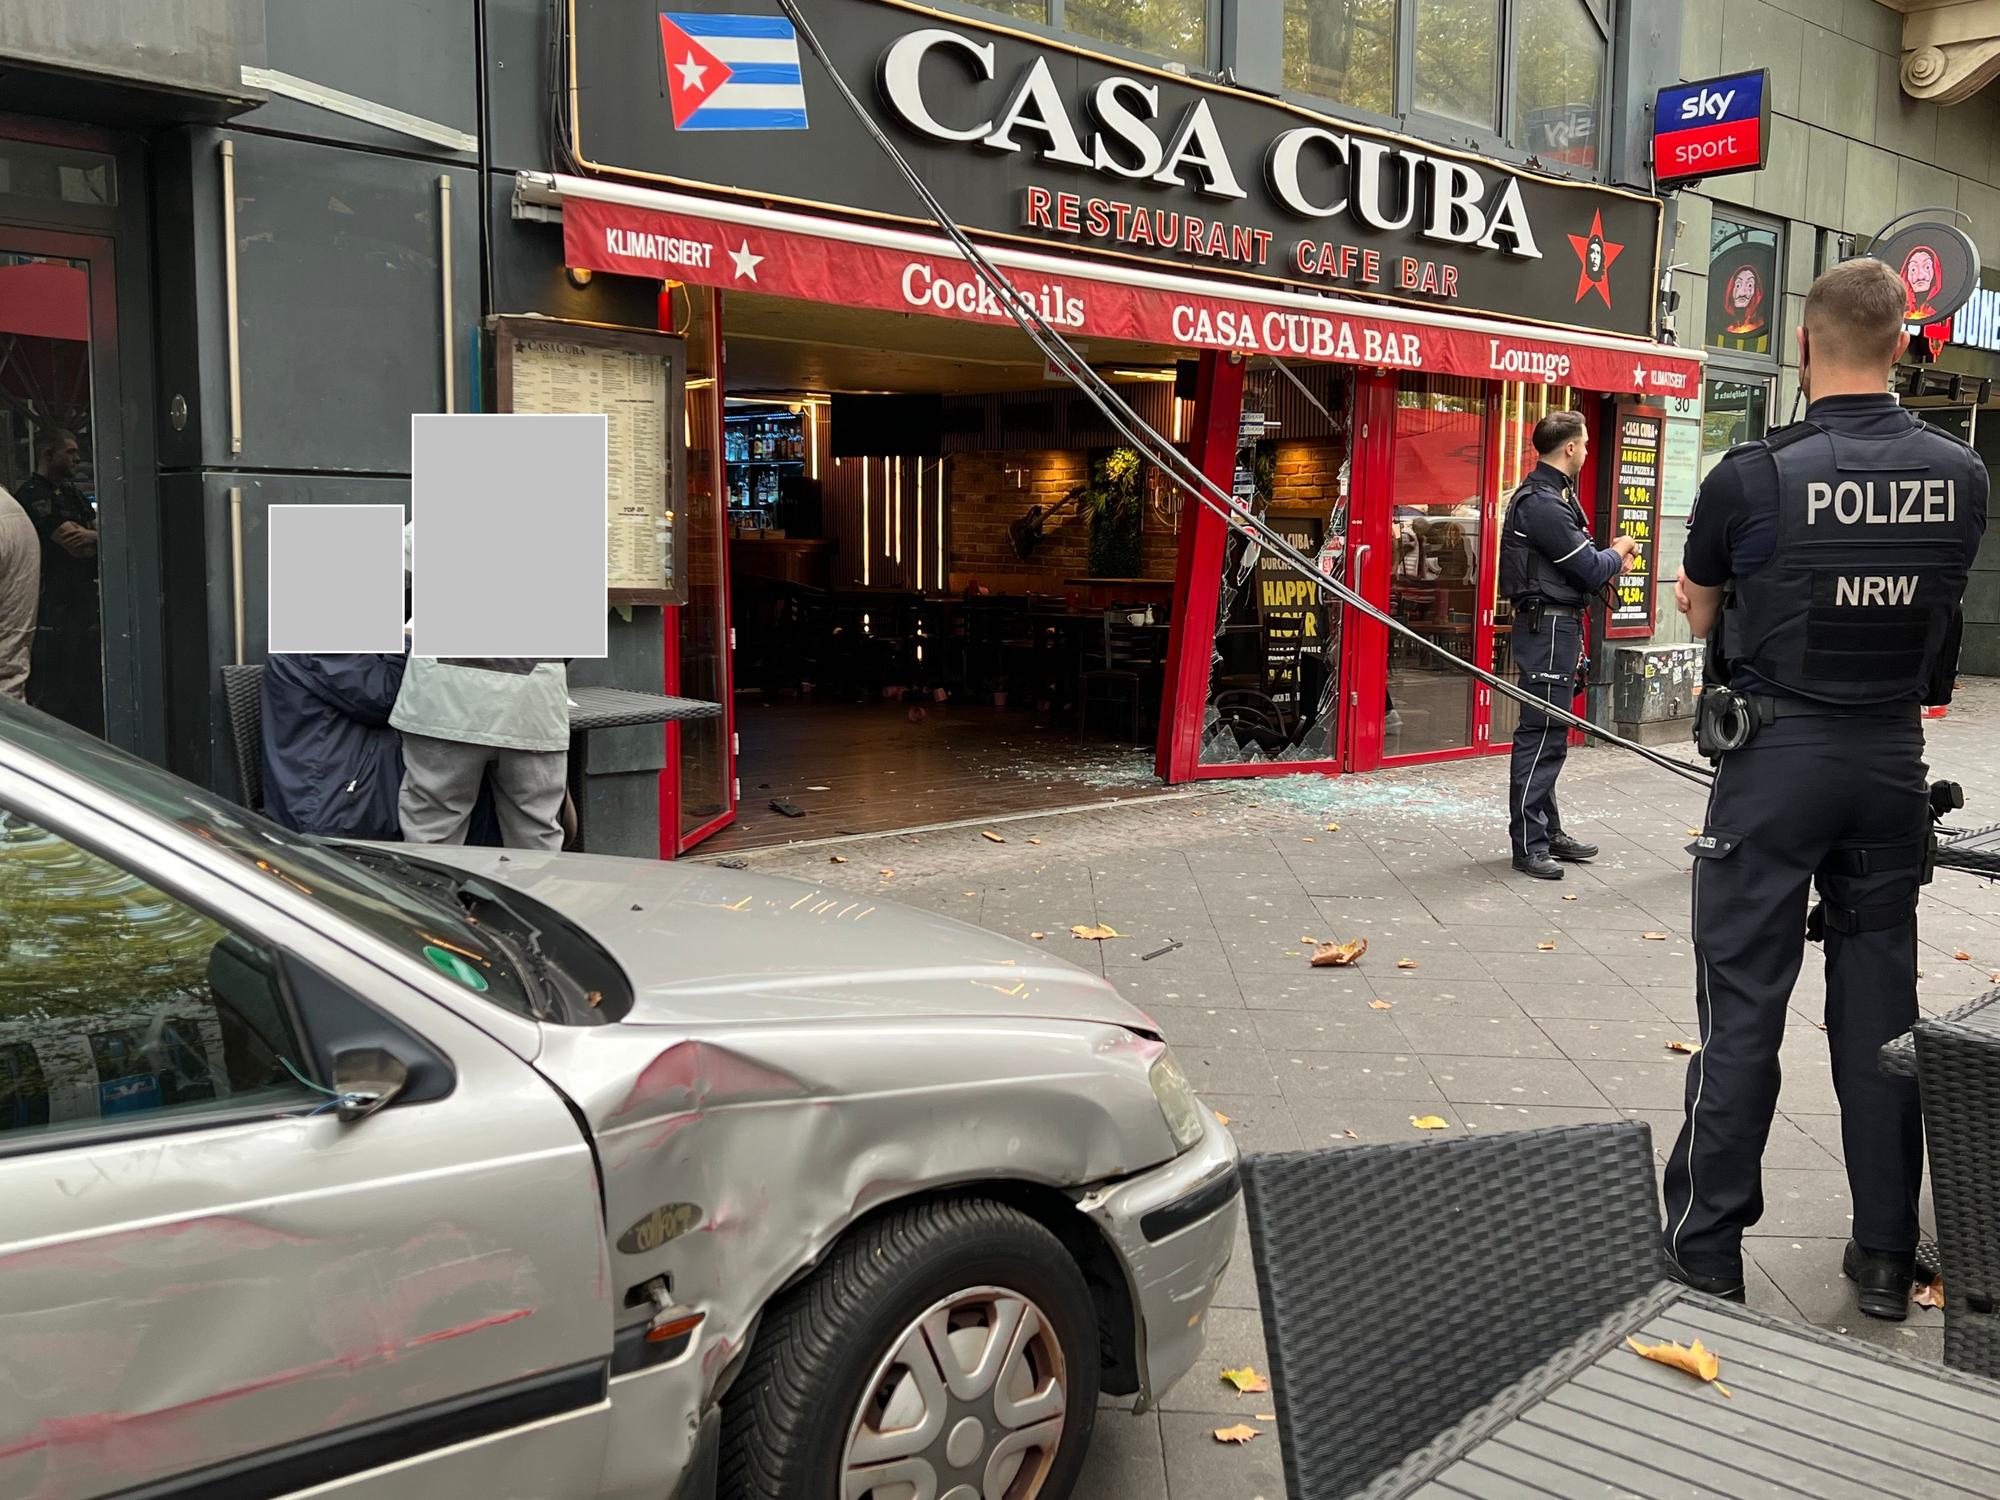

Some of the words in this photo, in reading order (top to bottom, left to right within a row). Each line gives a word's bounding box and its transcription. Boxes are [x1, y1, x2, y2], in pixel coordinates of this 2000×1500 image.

[1681, 88, 1736, 120] sky
[879, 28, 1248, 199] CASA
[1267, 126, 1543, 260] CUBA
[1675, 135, 1738, 165] sport
[605, 227, 714, 269] KLIMATISIERT
[1026, 185, 1273, 266] RESTAURANT
[1296, 239, 1380, 284] CAFE
[1401, 256, 1459, 298] BAR
[901, 262, 1085, 328] Cocktails
[1172, 304, 1259, 349] CASA
[1262, 311, 1360, 360] CUBA
[1363, 328, 1423, 368] BAR
[1489, 339, 1571, 384] Lounge
[1674, 396, 1690, 413] 30
[1625, 421, 1640, 437] CASA
[1640, 423, 1655, 439] CUBA
[1621, 449, 1656, 464] ANGEBOT
[1623, 509, 1648, 521] BURGER
[1807, 479, 1955, 525] POLIZEI
[1262, 580, 1317, 606] HAPPY
[1619, 576, 1645, 588] NACHOS
[1835, 575, 1920, 607] NRW
